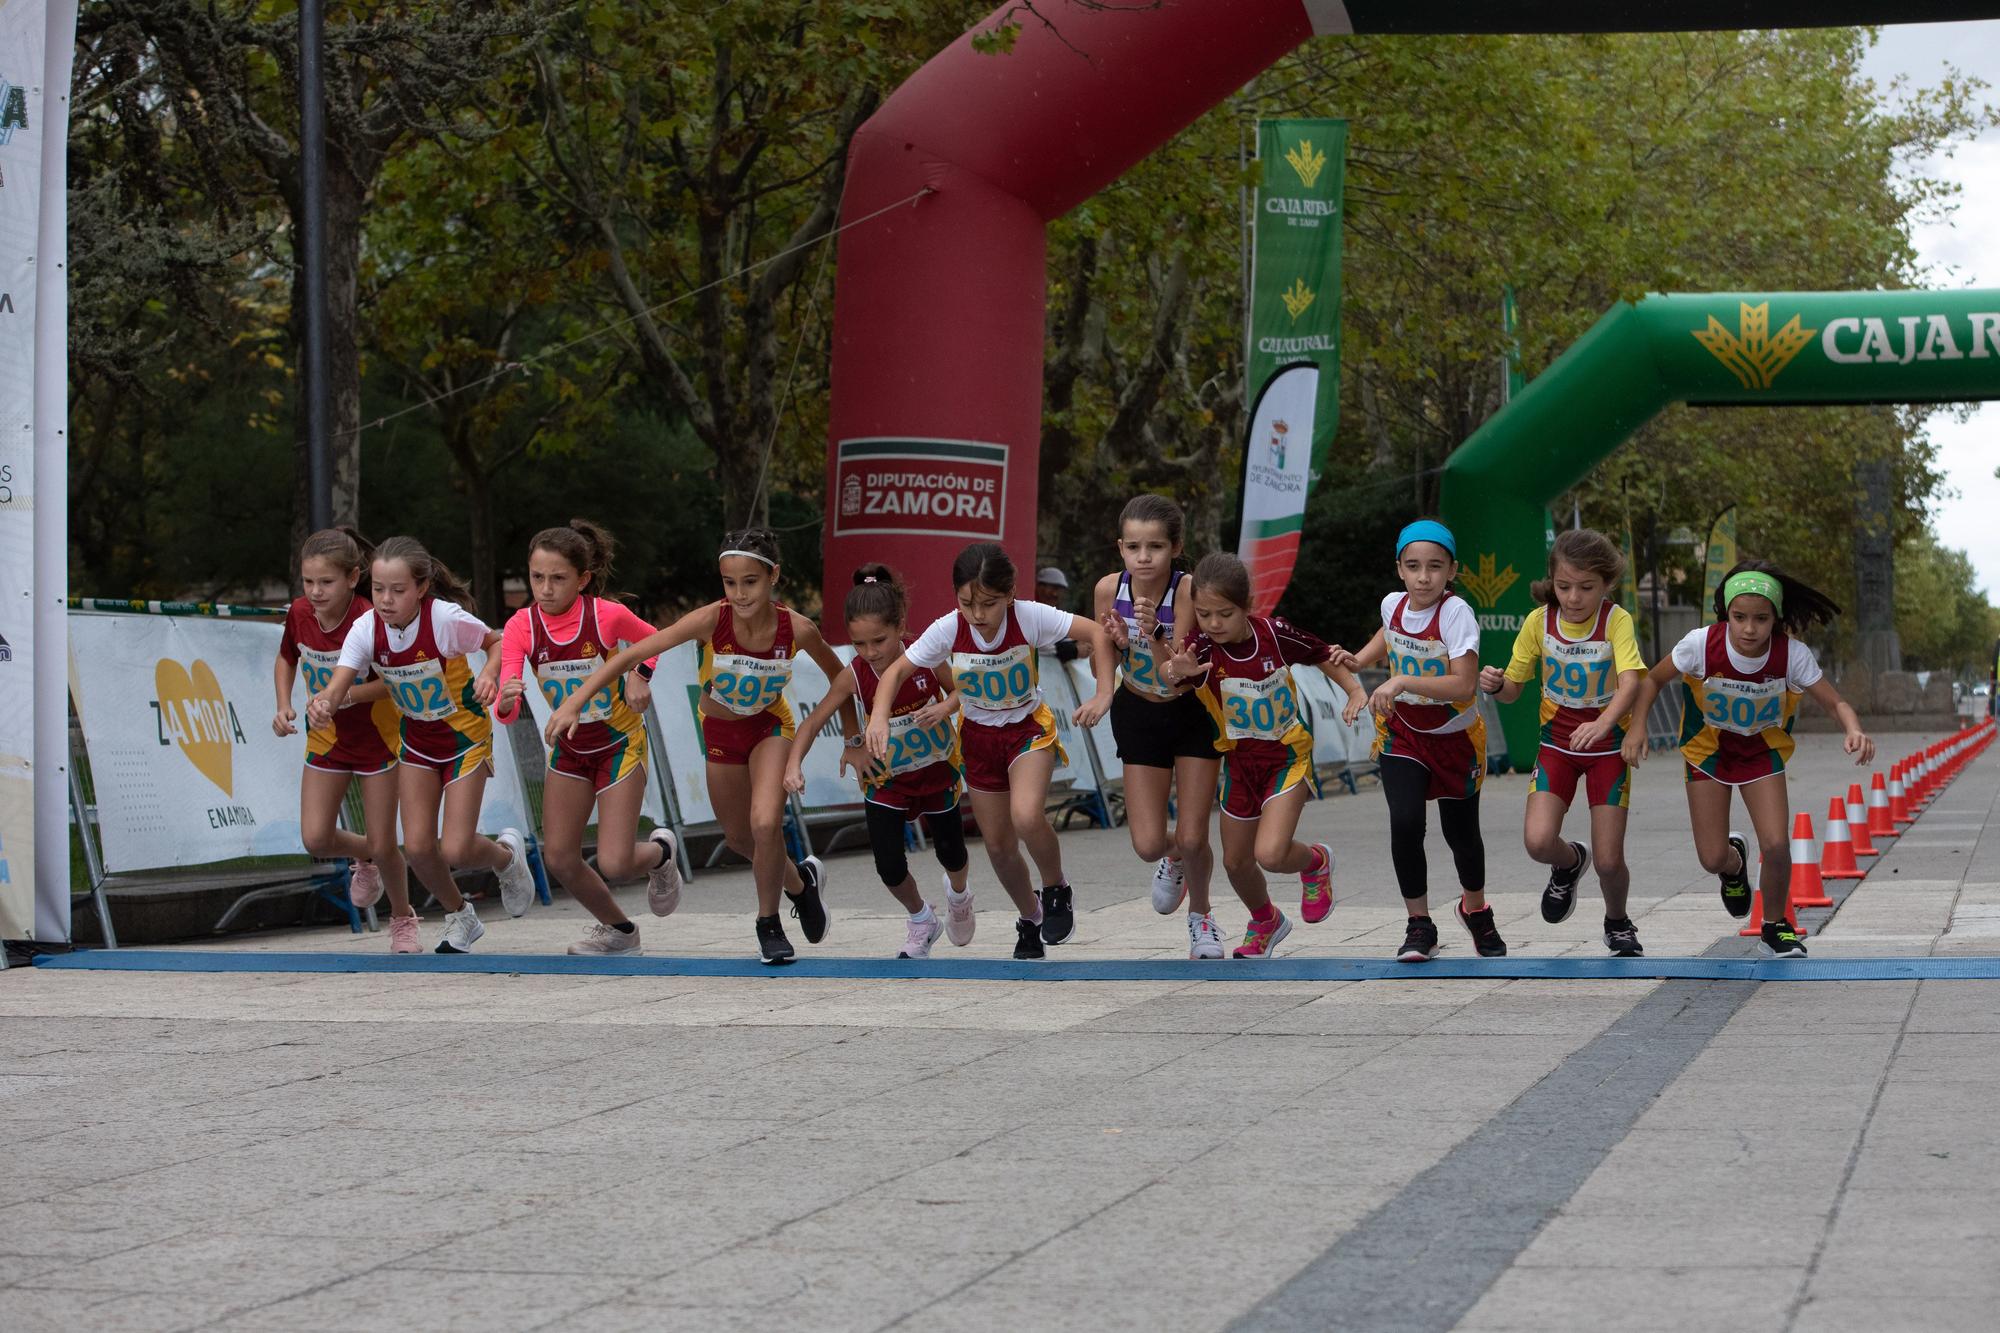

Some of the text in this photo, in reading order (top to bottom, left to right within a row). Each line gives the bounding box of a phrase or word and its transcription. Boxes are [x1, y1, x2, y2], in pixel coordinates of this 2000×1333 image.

[867, 473, 995, 493] DIPUTACIÓN DE
[864, 491, 995, 520] ZAMORA
[1478, 614, 1526, 631] RURA
[715, 672, 787, 707] 295
[958, 663, 1030, 701] 300
[1545, 656, 1612, 698] 297
[150, 699, 247, 746] ZAMORA
[1226, 687, 1295, 731] 303
[1706, 692, 1780, 728] 304
[207, 805, 256, 829] ENAMORA
